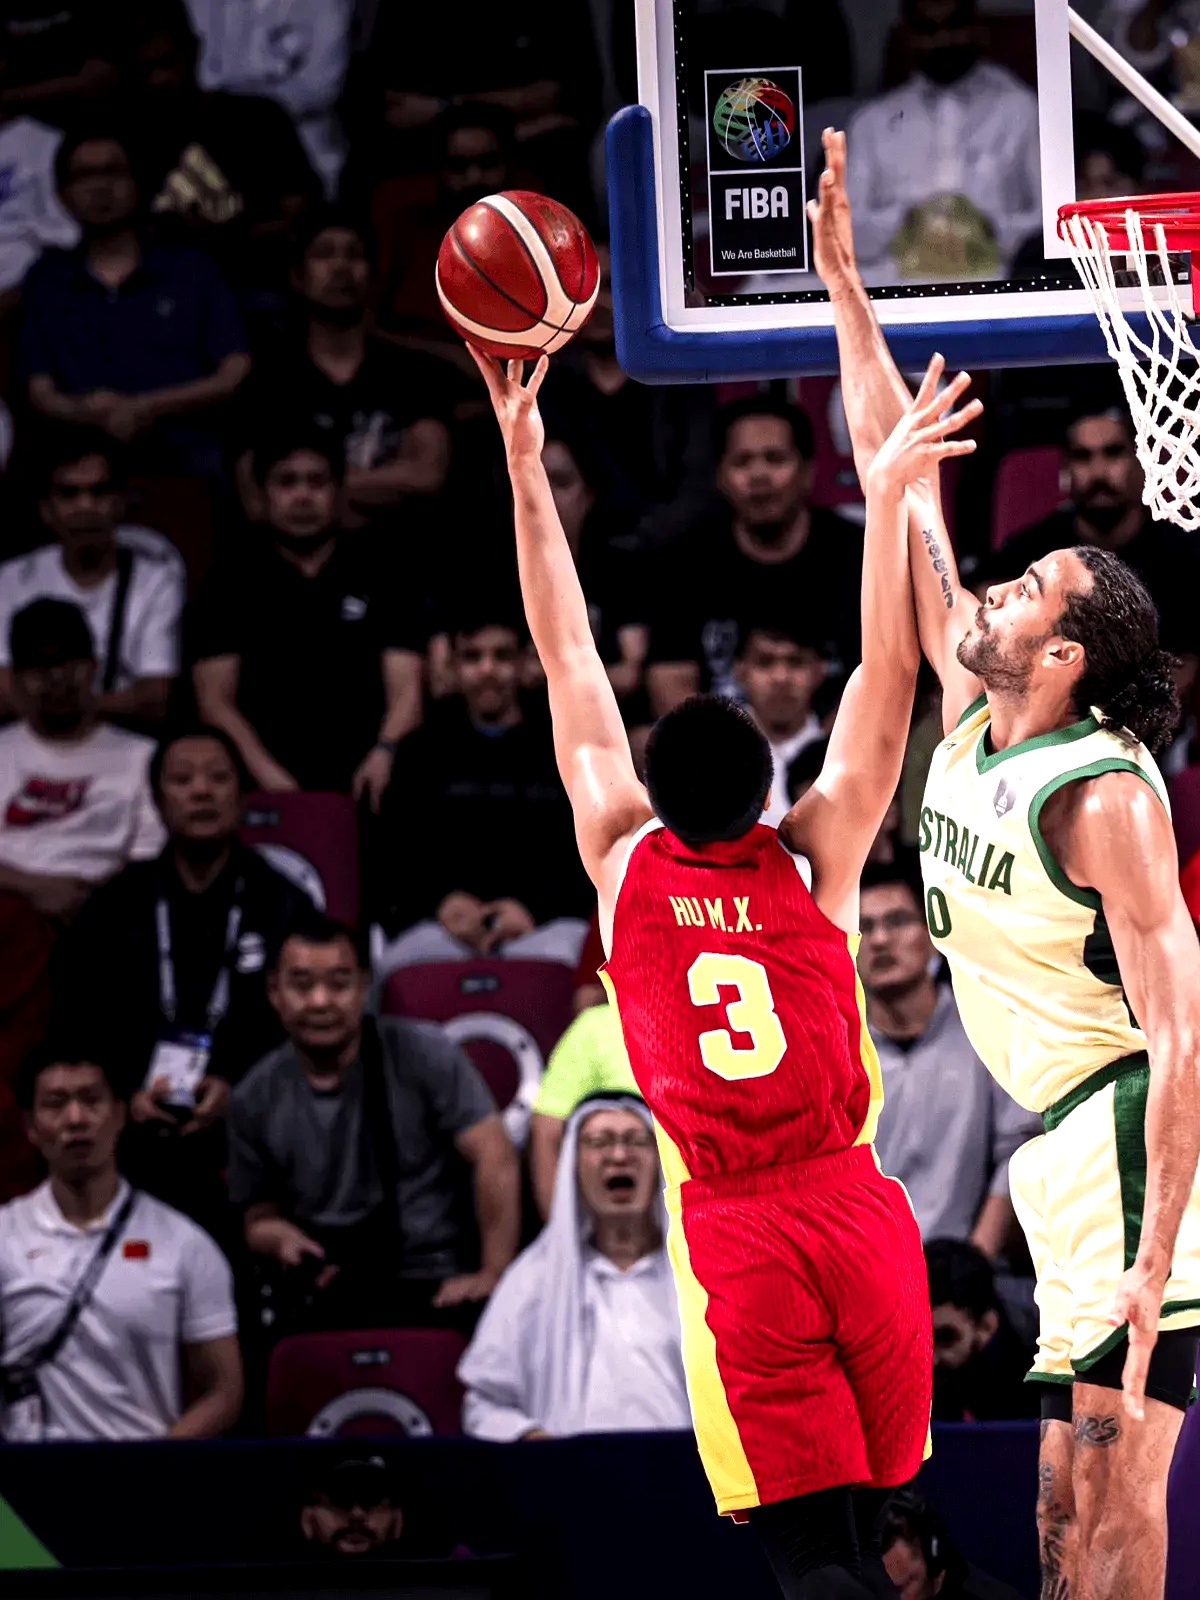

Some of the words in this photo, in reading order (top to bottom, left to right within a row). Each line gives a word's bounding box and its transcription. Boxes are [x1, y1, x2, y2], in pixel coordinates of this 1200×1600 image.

[724, 185, 789, 220] FIBA
[721, 250, 736, 260] We
[737, 249, 753, 259] Are
[754, 247, 797, 259] Basketball
[668, 895, 705, 927] HU
[687, 951, 788, 1081] 3
